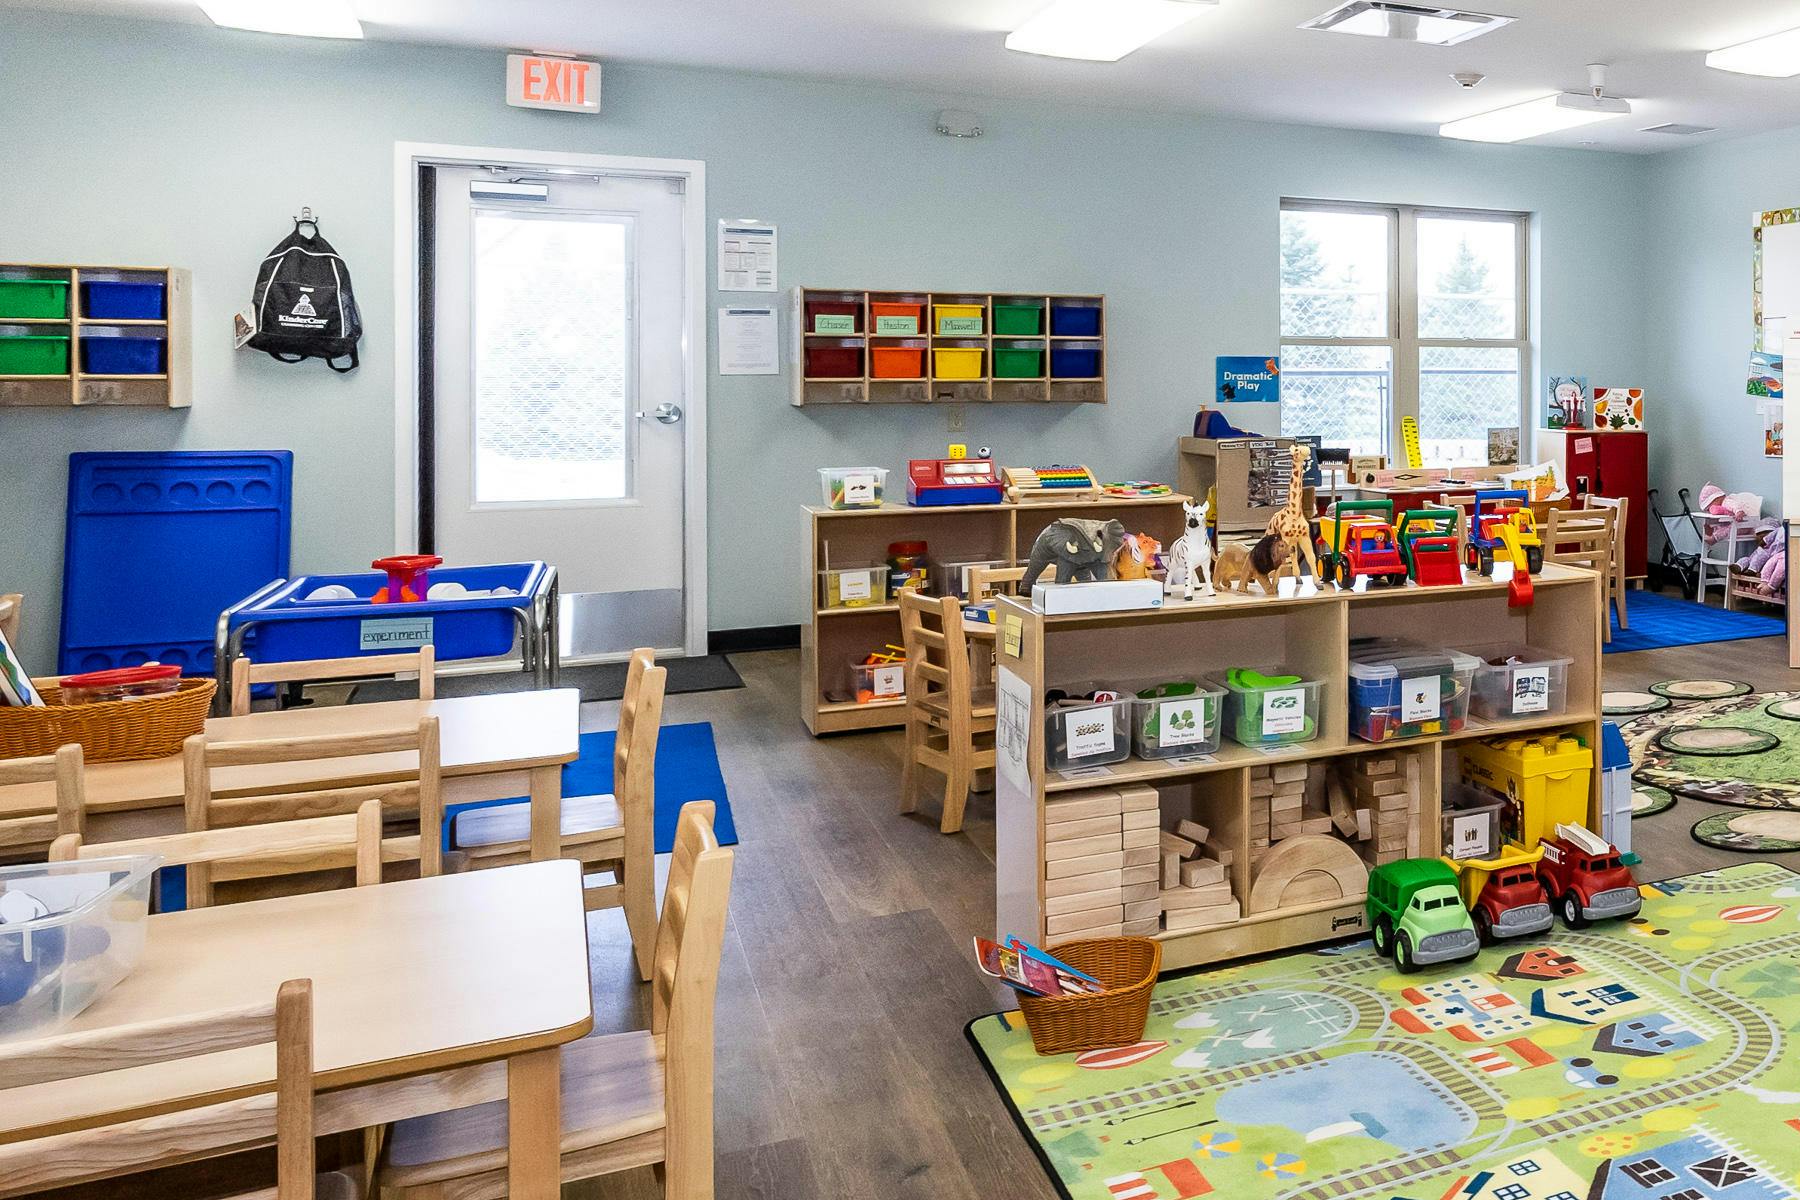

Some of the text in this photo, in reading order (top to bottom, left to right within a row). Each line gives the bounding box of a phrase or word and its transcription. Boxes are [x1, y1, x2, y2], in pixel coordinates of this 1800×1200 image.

[523, 58, 589, 105] EXIT
[944, 320, 977, 331] Maxwell
[1224, 371, 1273, 380] Dramatic
[1237, 381, 1260, 392] Play
[363, 623, 431, 644] experiment
